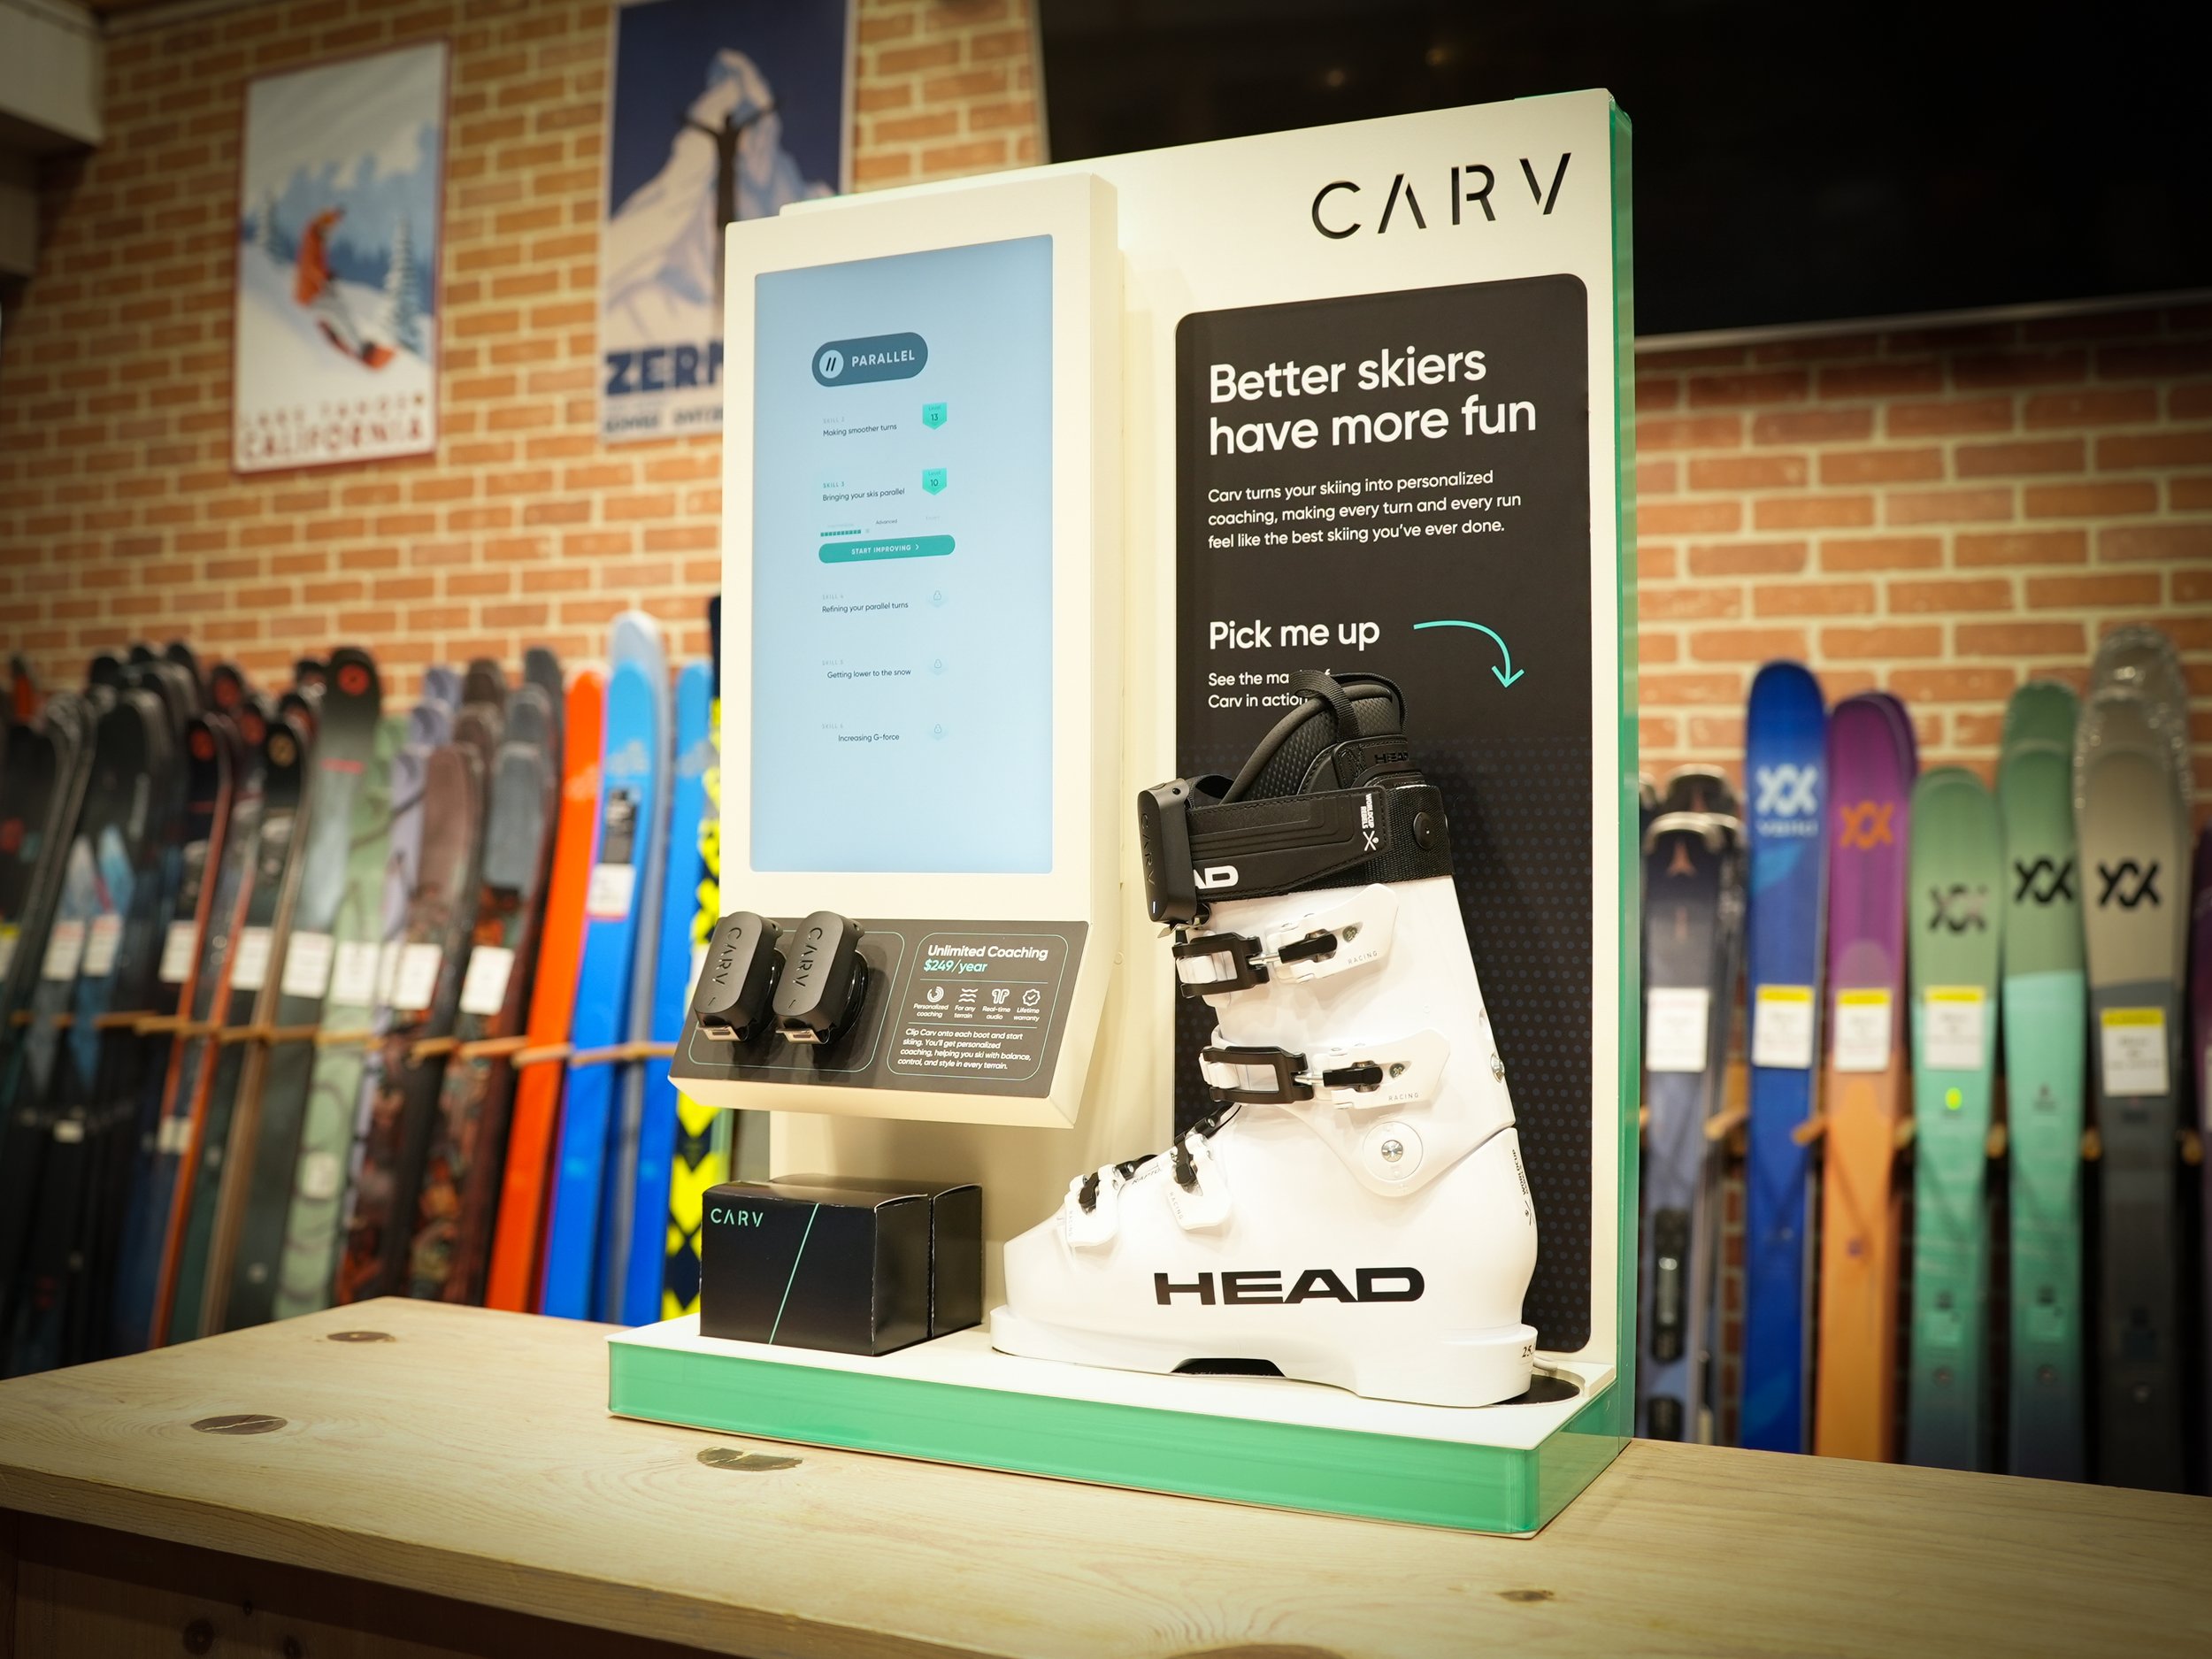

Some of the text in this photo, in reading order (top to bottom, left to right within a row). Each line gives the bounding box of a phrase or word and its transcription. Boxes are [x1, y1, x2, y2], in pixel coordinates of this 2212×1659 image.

[1311, 152, 1572, 240] CARV
[852, 349, 915, 367] PARALLEL
[1210, 346, 1486, 403] Better skiers
[849, 426, 878, 434] smoother
[1210, 394, 1536, 456] have more fun
[1208, 470, 1494, 503] Carv turns your skiing into personalized
[822, 494, 849, 502] Bringing
[880, 488, 905, 498] parallel
[1208, 495, 1521, 526] coaching, making every turn and every run
[1208, 534, 1234, 549] feel
[1238, 533, 1261, 547] like
[1264, 532, 1288, 545] the
[1292, 530, 1324, 544] best
[1327, 527, 1368, 543] skiing
[1425, 523, 1458, 536] ever
[1461, 519, 1505, 534] done.
[852, 545, 911, 555] START IMPROVING
[822, 605, 848, 613] Refining
[865, 602, 891, 611] parallel
[1210, 620, 1380, 651] Pick me up
[827, 671, 852, 679] Getting
[1208, 672, 1235, 686] See
[1239, 672, 1263, 685] the
[1208, 694, 1243, 708] Carv
[1246, 694, 1258, 707] in
[838, 734, 872, 743] Increasing
[1141, 813, 1155, 885] CARV
[712, 926, 742, 985] CARV
[793, 926, 822, 987] CARV
[928, 945, 1048, 961] Unlimited Coaching
[1348, 951, 1378, 964] RACING
[924, 959, 987, 974] $249/year
[906, 1028, 919, 1037] Clip
[902, 1038, 923, 1047] skiing.
[900, 1048, 933, 1057] coaching,
[934, 1049, 960, 1059] helping
[1001, 1052, 1031, 1061] balance,
[1389, 1091, 1420, 1101] RACING
[710, 1208, 764, 1228] CARV
[1154, 1267, 1425, 1306] HEAD
